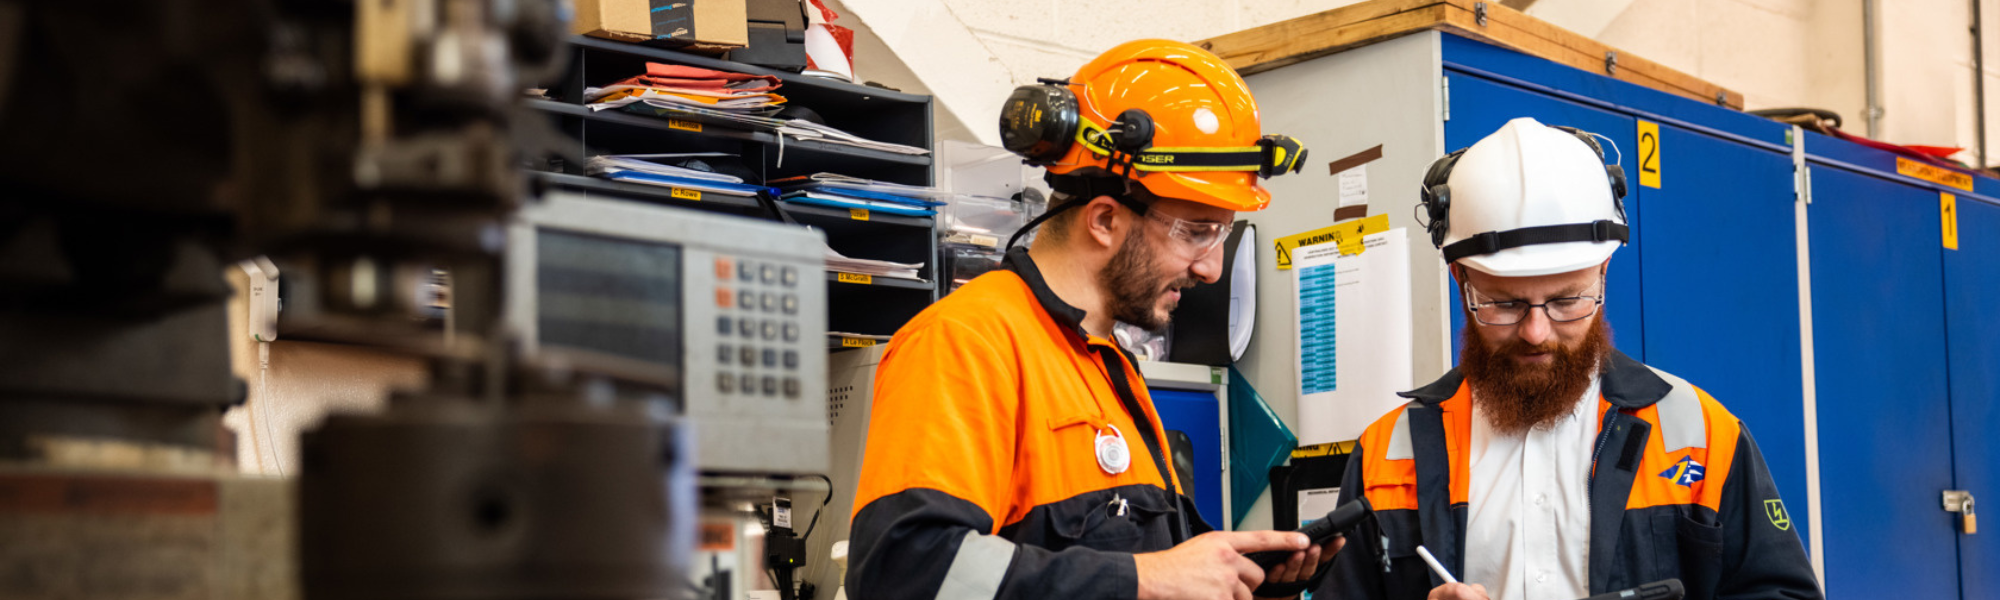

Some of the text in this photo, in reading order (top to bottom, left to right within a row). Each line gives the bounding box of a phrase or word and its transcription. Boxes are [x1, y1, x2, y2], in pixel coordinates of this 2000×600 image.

[1641, 131, 1656, 174] 2
[673, 188, 698, 198] C Rowe
[1944, 203, 1953, 237] 1
